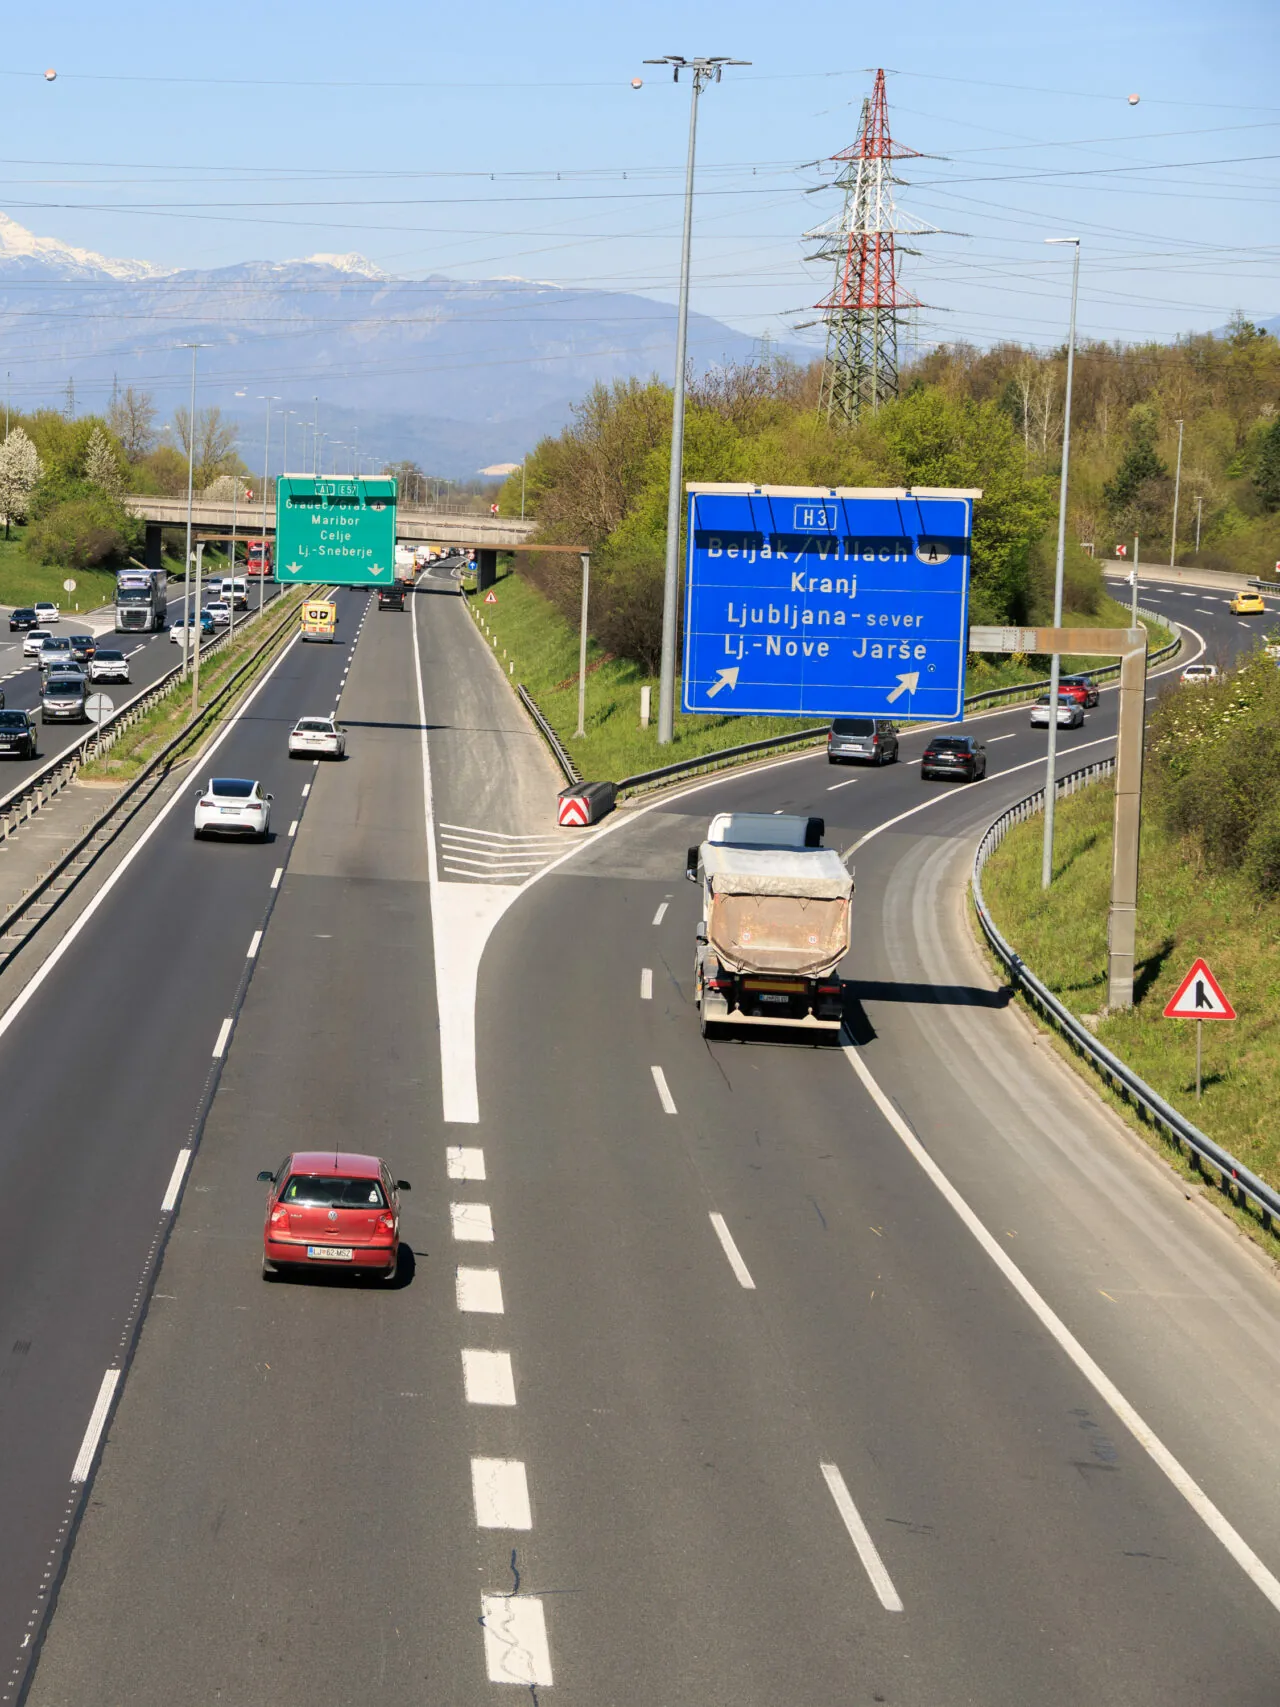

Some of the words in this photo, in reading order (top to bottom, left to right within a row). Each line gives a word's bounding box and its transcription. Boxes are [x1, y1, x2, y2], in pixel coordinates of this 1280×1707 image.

[311, 514, 360, 526] Maribor
[320, 530, 352, 543] Celje
[790, 571, 858, 599] Kranj
[727, 602, 924, 630] Ljubljana-sever
[852, 639, 928, 661] Jarše
